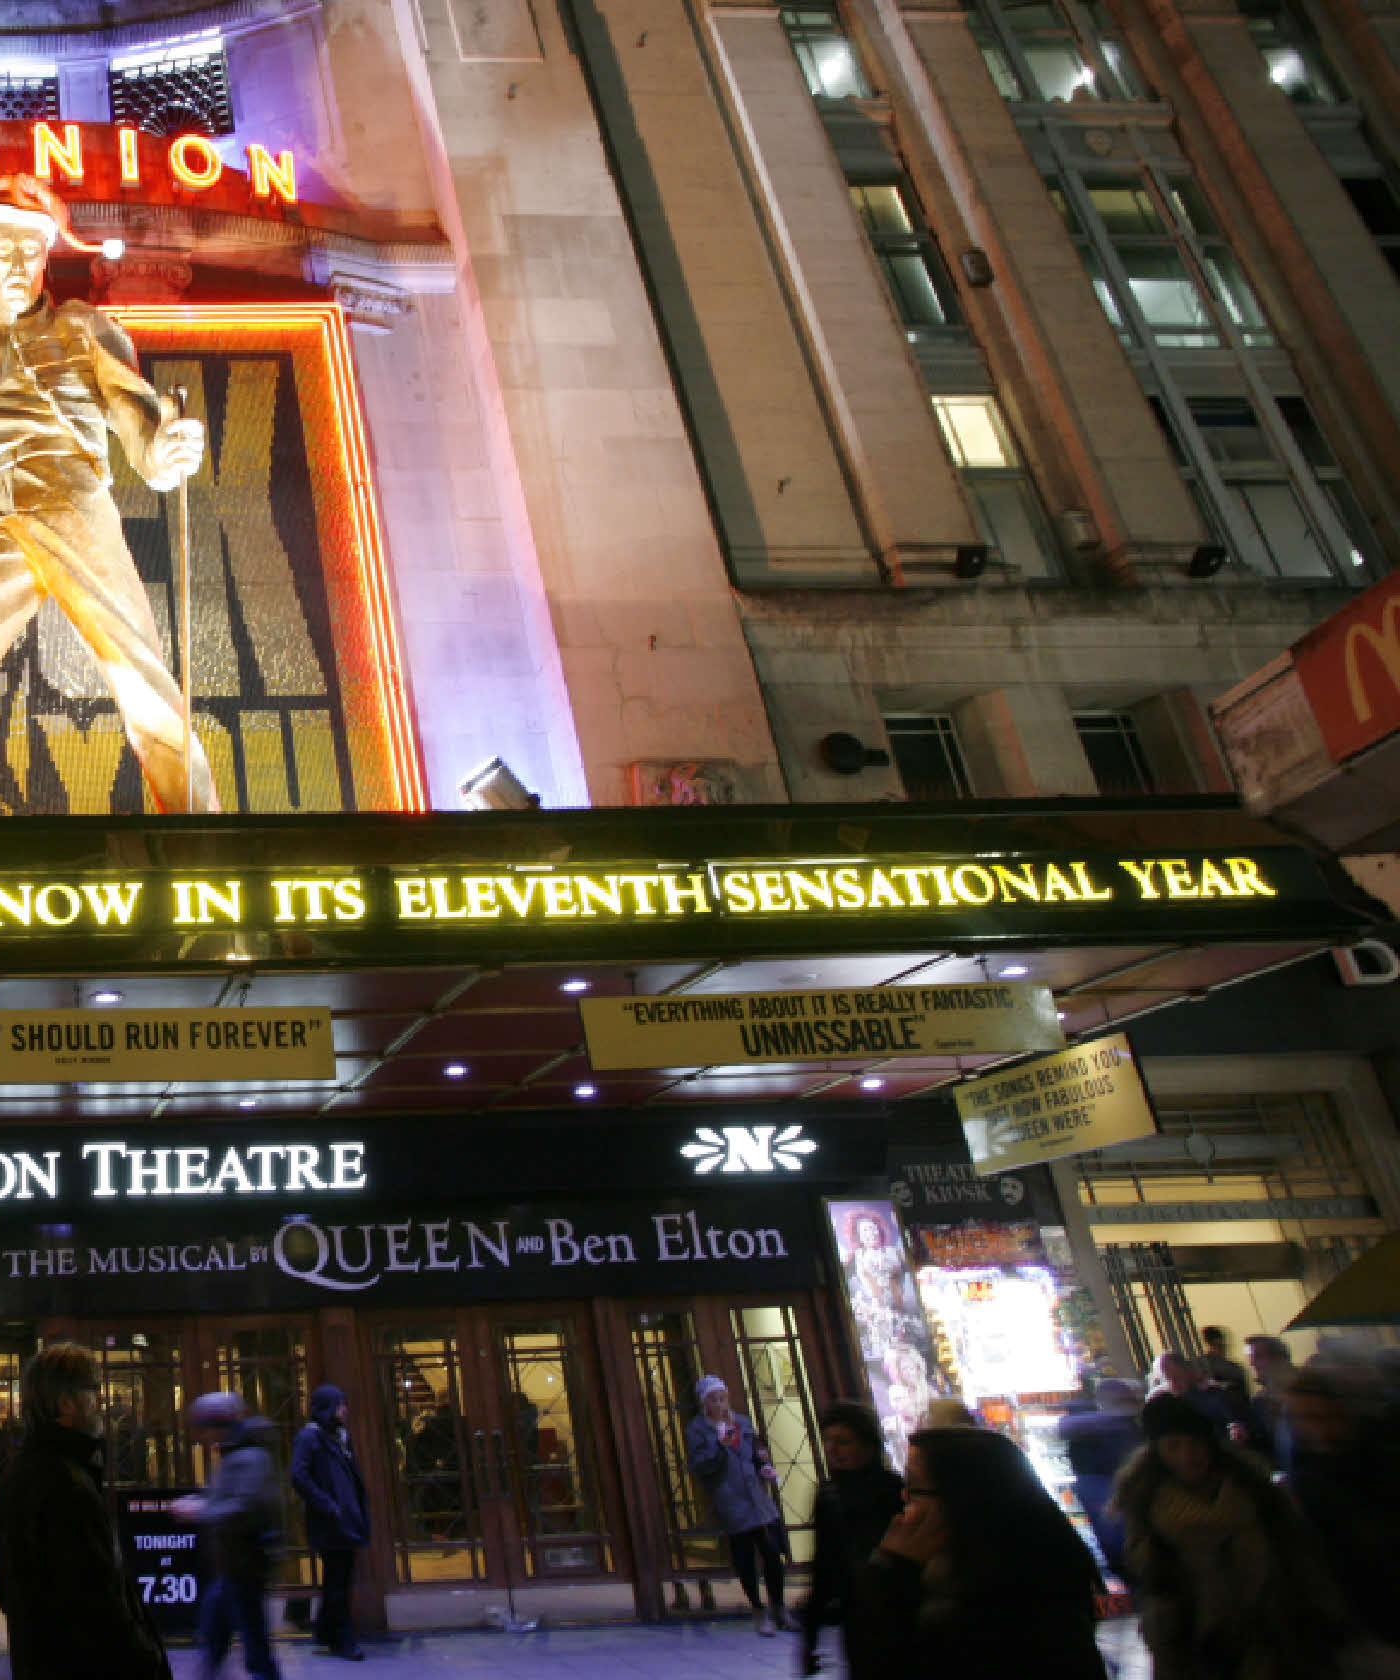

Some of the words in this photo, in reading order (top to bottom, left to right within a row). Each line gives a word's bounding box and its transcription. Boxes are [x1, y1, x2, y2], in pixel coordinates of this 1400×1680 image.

[172, 880, 243, 925] IN
[270, 877, 366, 922] ITS
[394, 874, 712, 919] ELEVENTH
[721, 860, 1114, 913] SENSATIONAL
[1118, 856, 1279, 899] YEAR
[623, 998, 743, 1025] "EVERYTHING
[750, 995, 804, 1019] ABOUT
[807, 994, 828, 1015] IT
[831, 994, 852, 1015] IS
[854, 989, 917, 1013] REALLY
[921, 987, 1014, 1011] FANTASTIC
[10, 1021, 115, 1052] SHOULD
[125, 1021, 180, 1051] RUN
[189, 1018, 323, 1050] FOREVER"
[740, 1012, 927, 1057] UNMISSABLE"
[1035, 1057, 1090, 1088] REMIND
[1090, 1046, 1122, 1071] YOU
[1043, 1074, 1115, 1106] FABULOUS
[81, 1141, 368, 1198] THEATRE
[2, 1248, 78, 1279] THE
[87, 1242, 249, 1275] MUSICAL
[249, 1246, 269, 1263] BY
[273, 1219, 511, 1291] QUEEN
[549, 1217, 637, 1266] Ben
[656, 1212, 789, 1262] Elton
[133, 1533, 197, 1550] TONIGHT
[137, 1573, 198, 1604] 7.30
